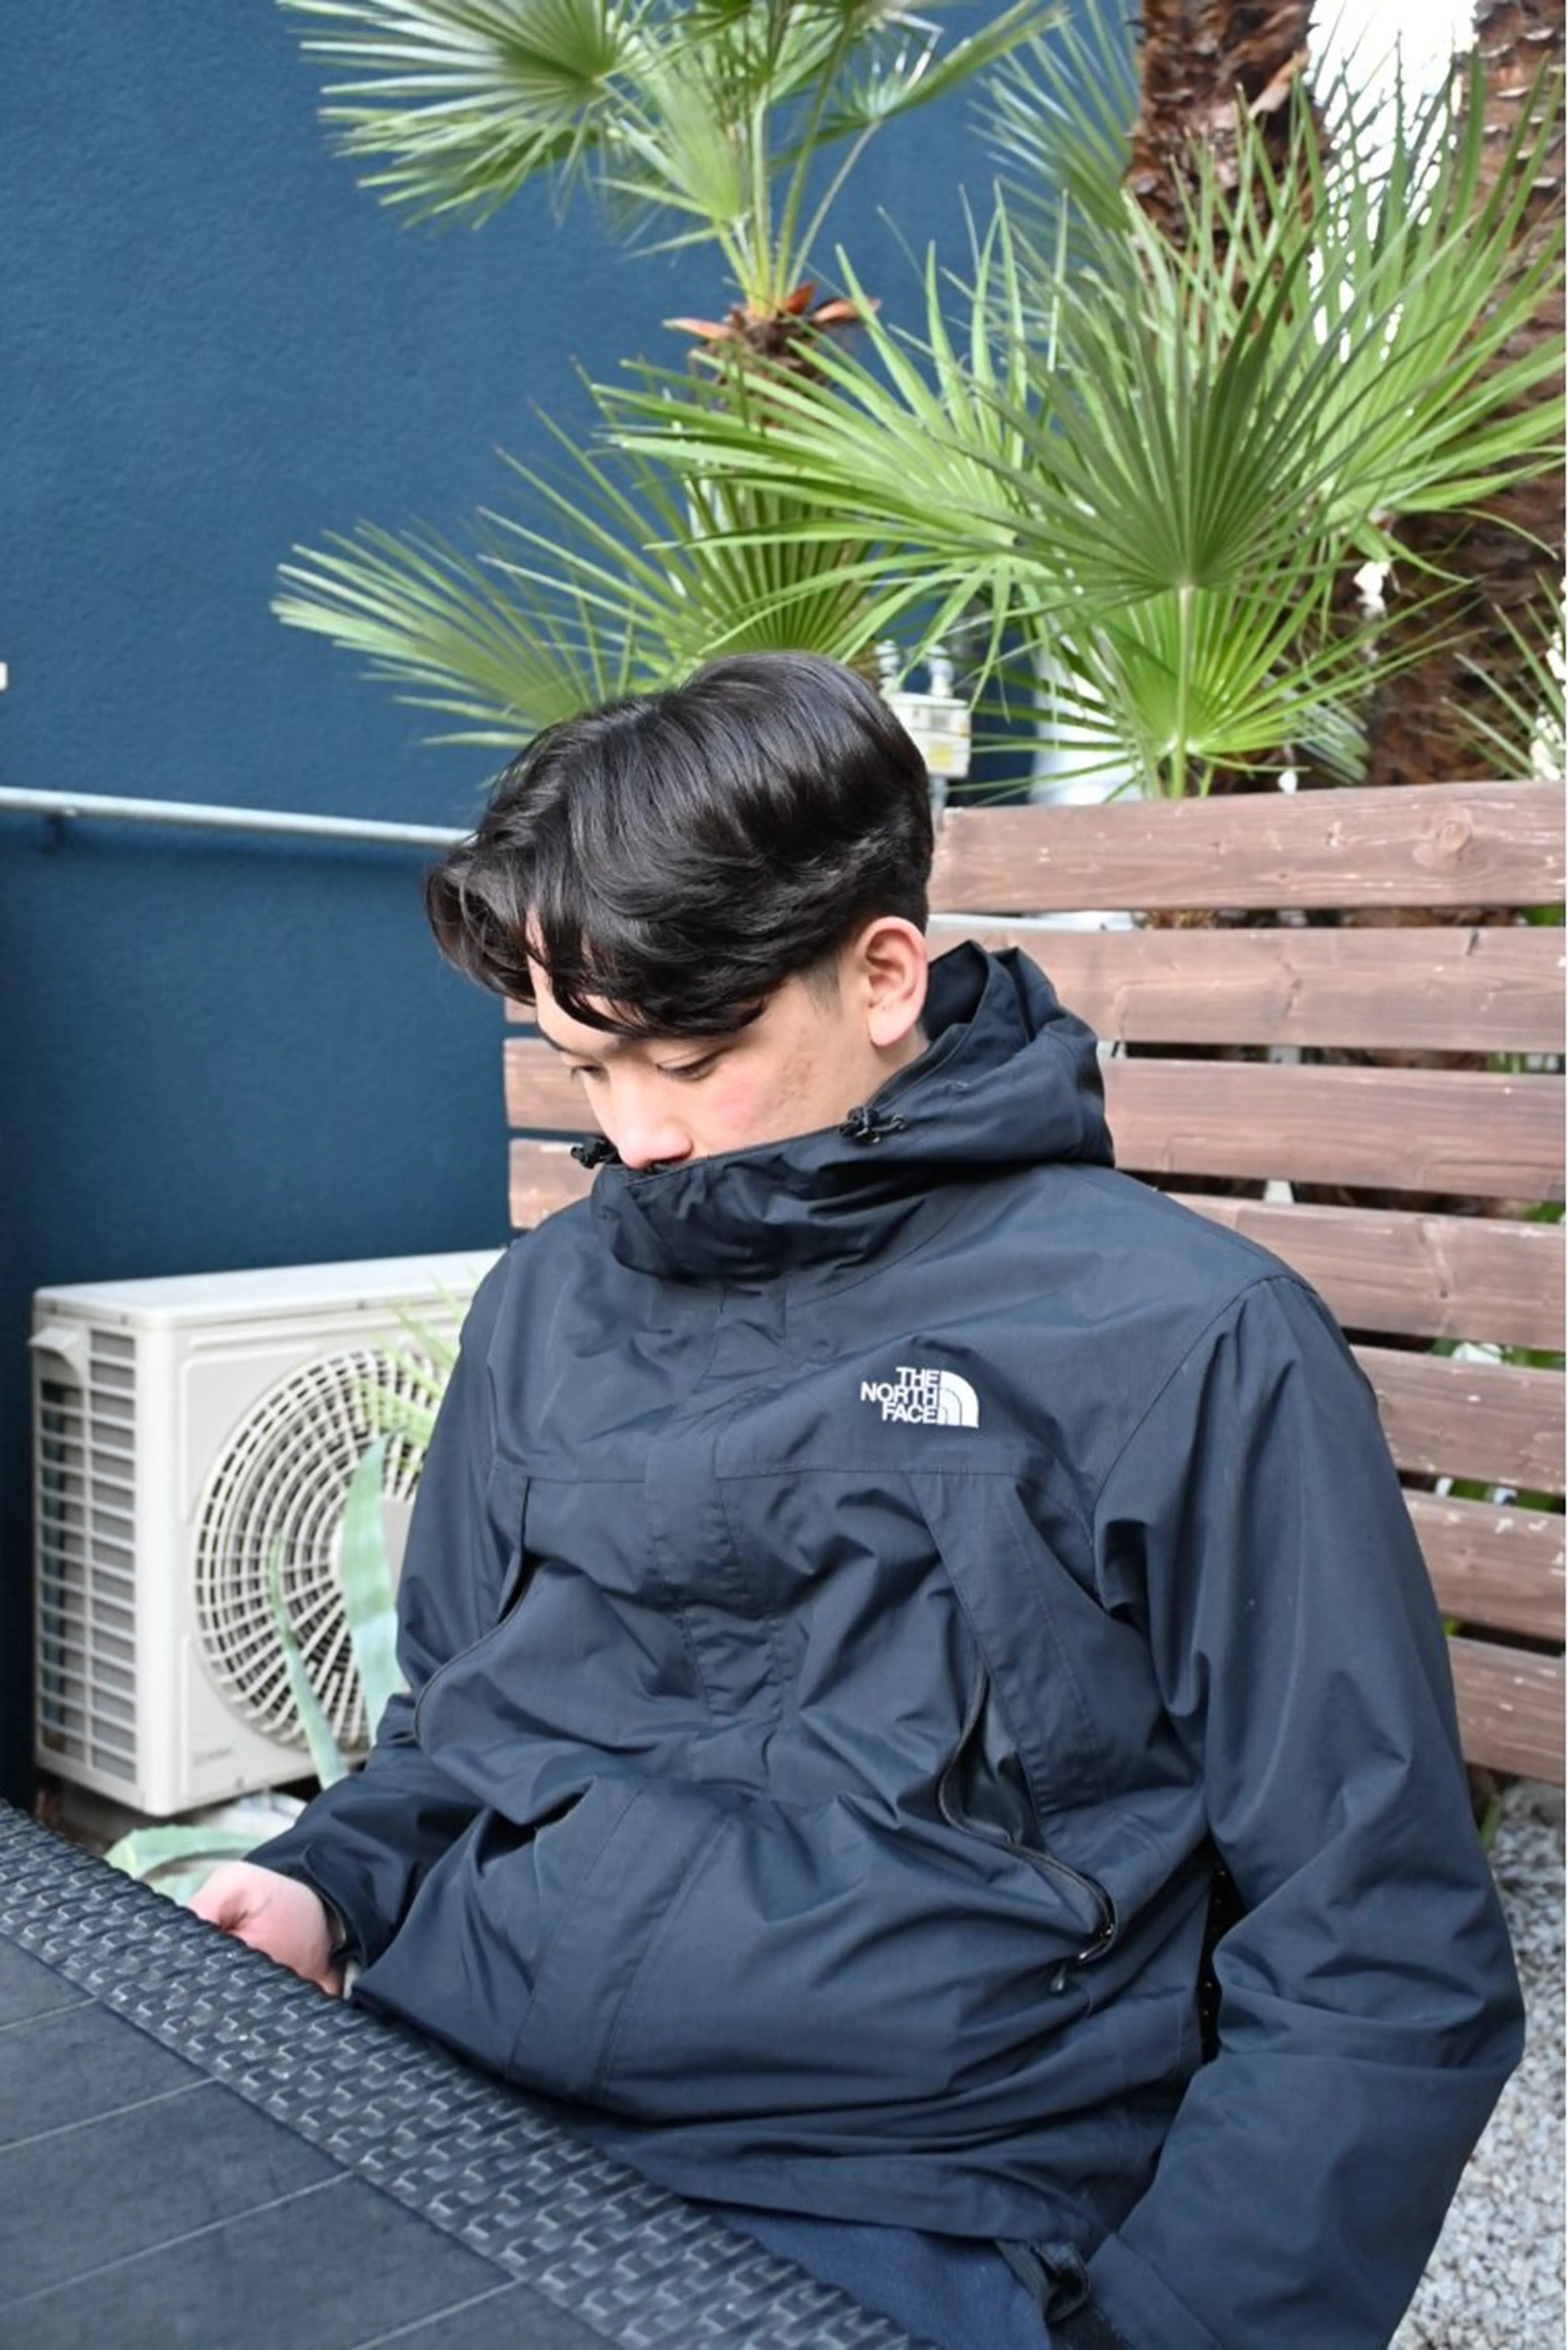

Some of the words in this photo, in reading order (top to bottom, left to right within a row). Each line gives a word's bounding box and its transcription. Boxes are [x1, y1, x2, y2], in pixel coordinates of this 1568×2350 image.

[895, 1366, 940, 1387] THE
[860, 1381, 938, 1408] NORTH
[882, 1401, 938, 1423] FACE
